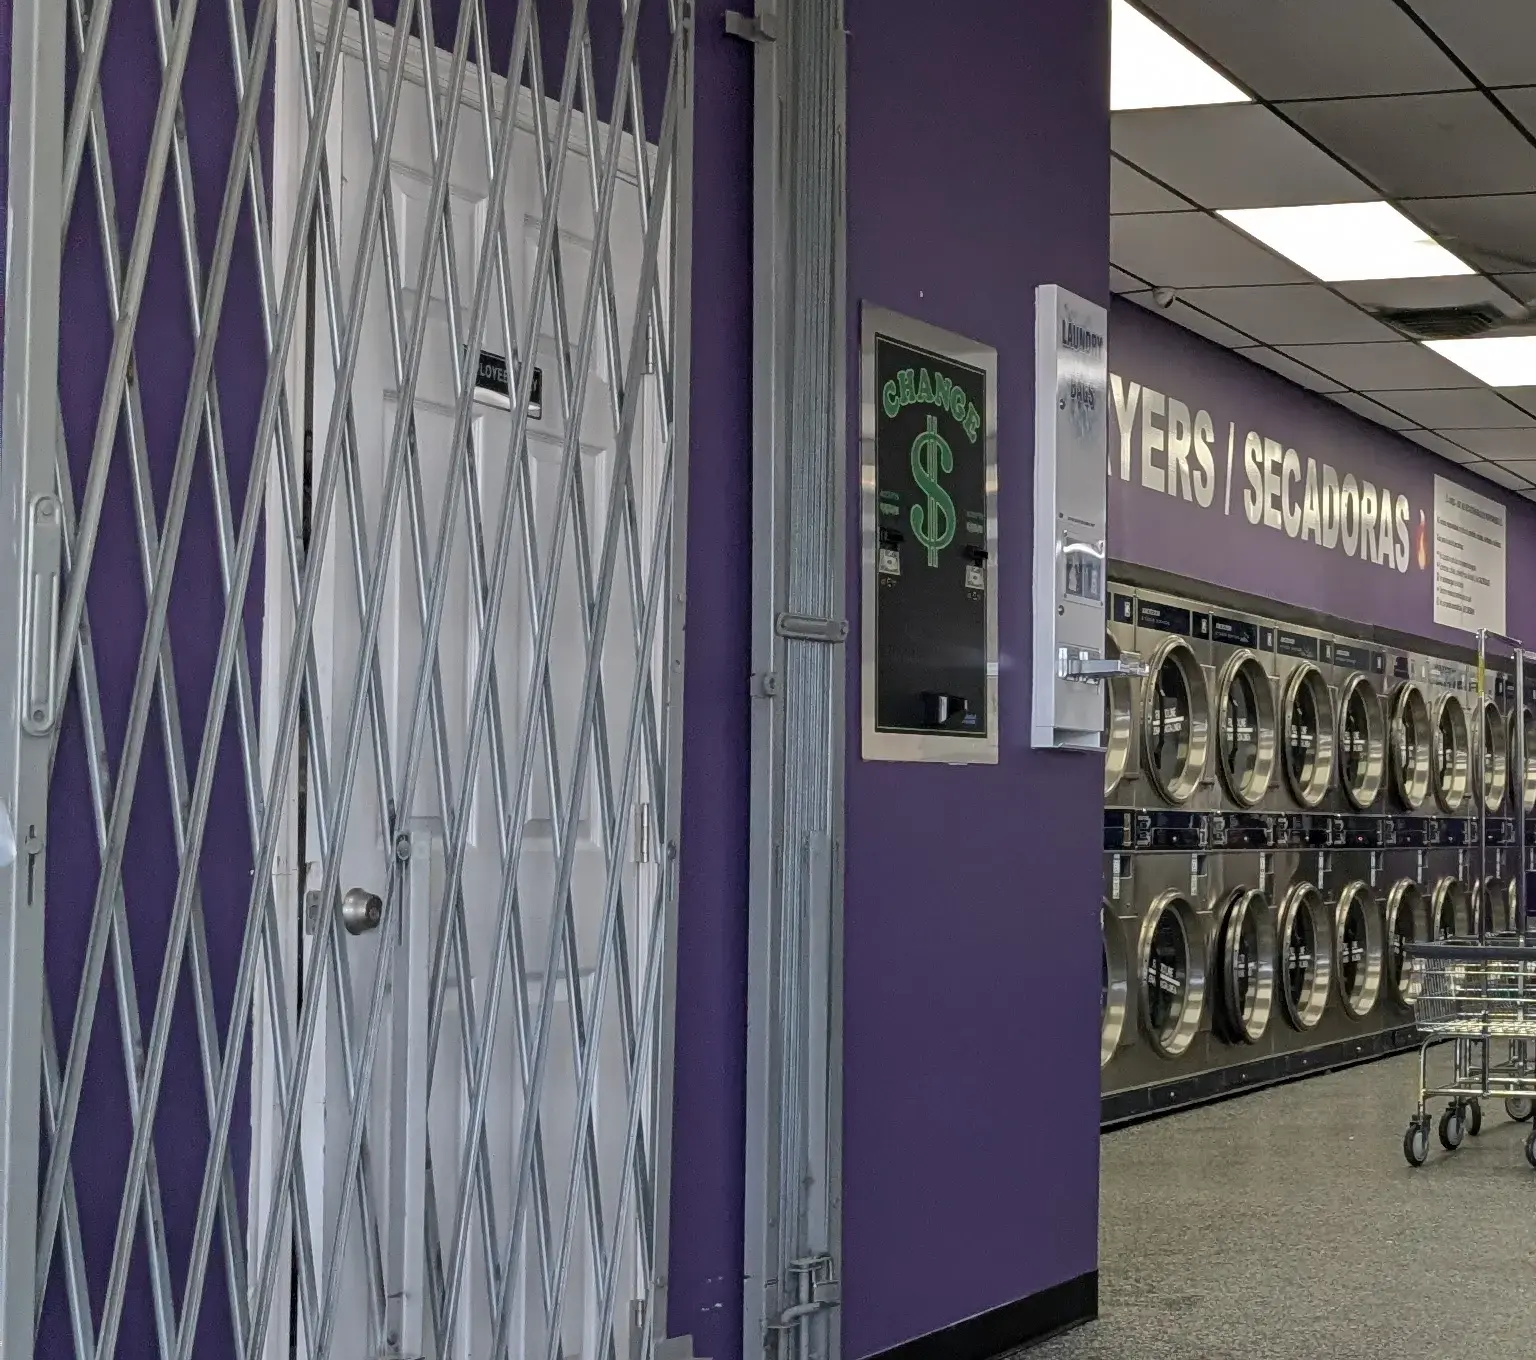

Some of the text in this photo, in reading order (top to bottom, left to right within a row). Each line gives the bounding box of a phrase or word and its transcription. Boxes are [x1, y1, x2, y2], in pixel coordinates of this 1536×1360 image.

[1062, 319, 1104, 351] LAUNDRY
[883, 368, 981, 443] CHANGE
[1107, 372, 1410, 573] YERS / SECADORAS
